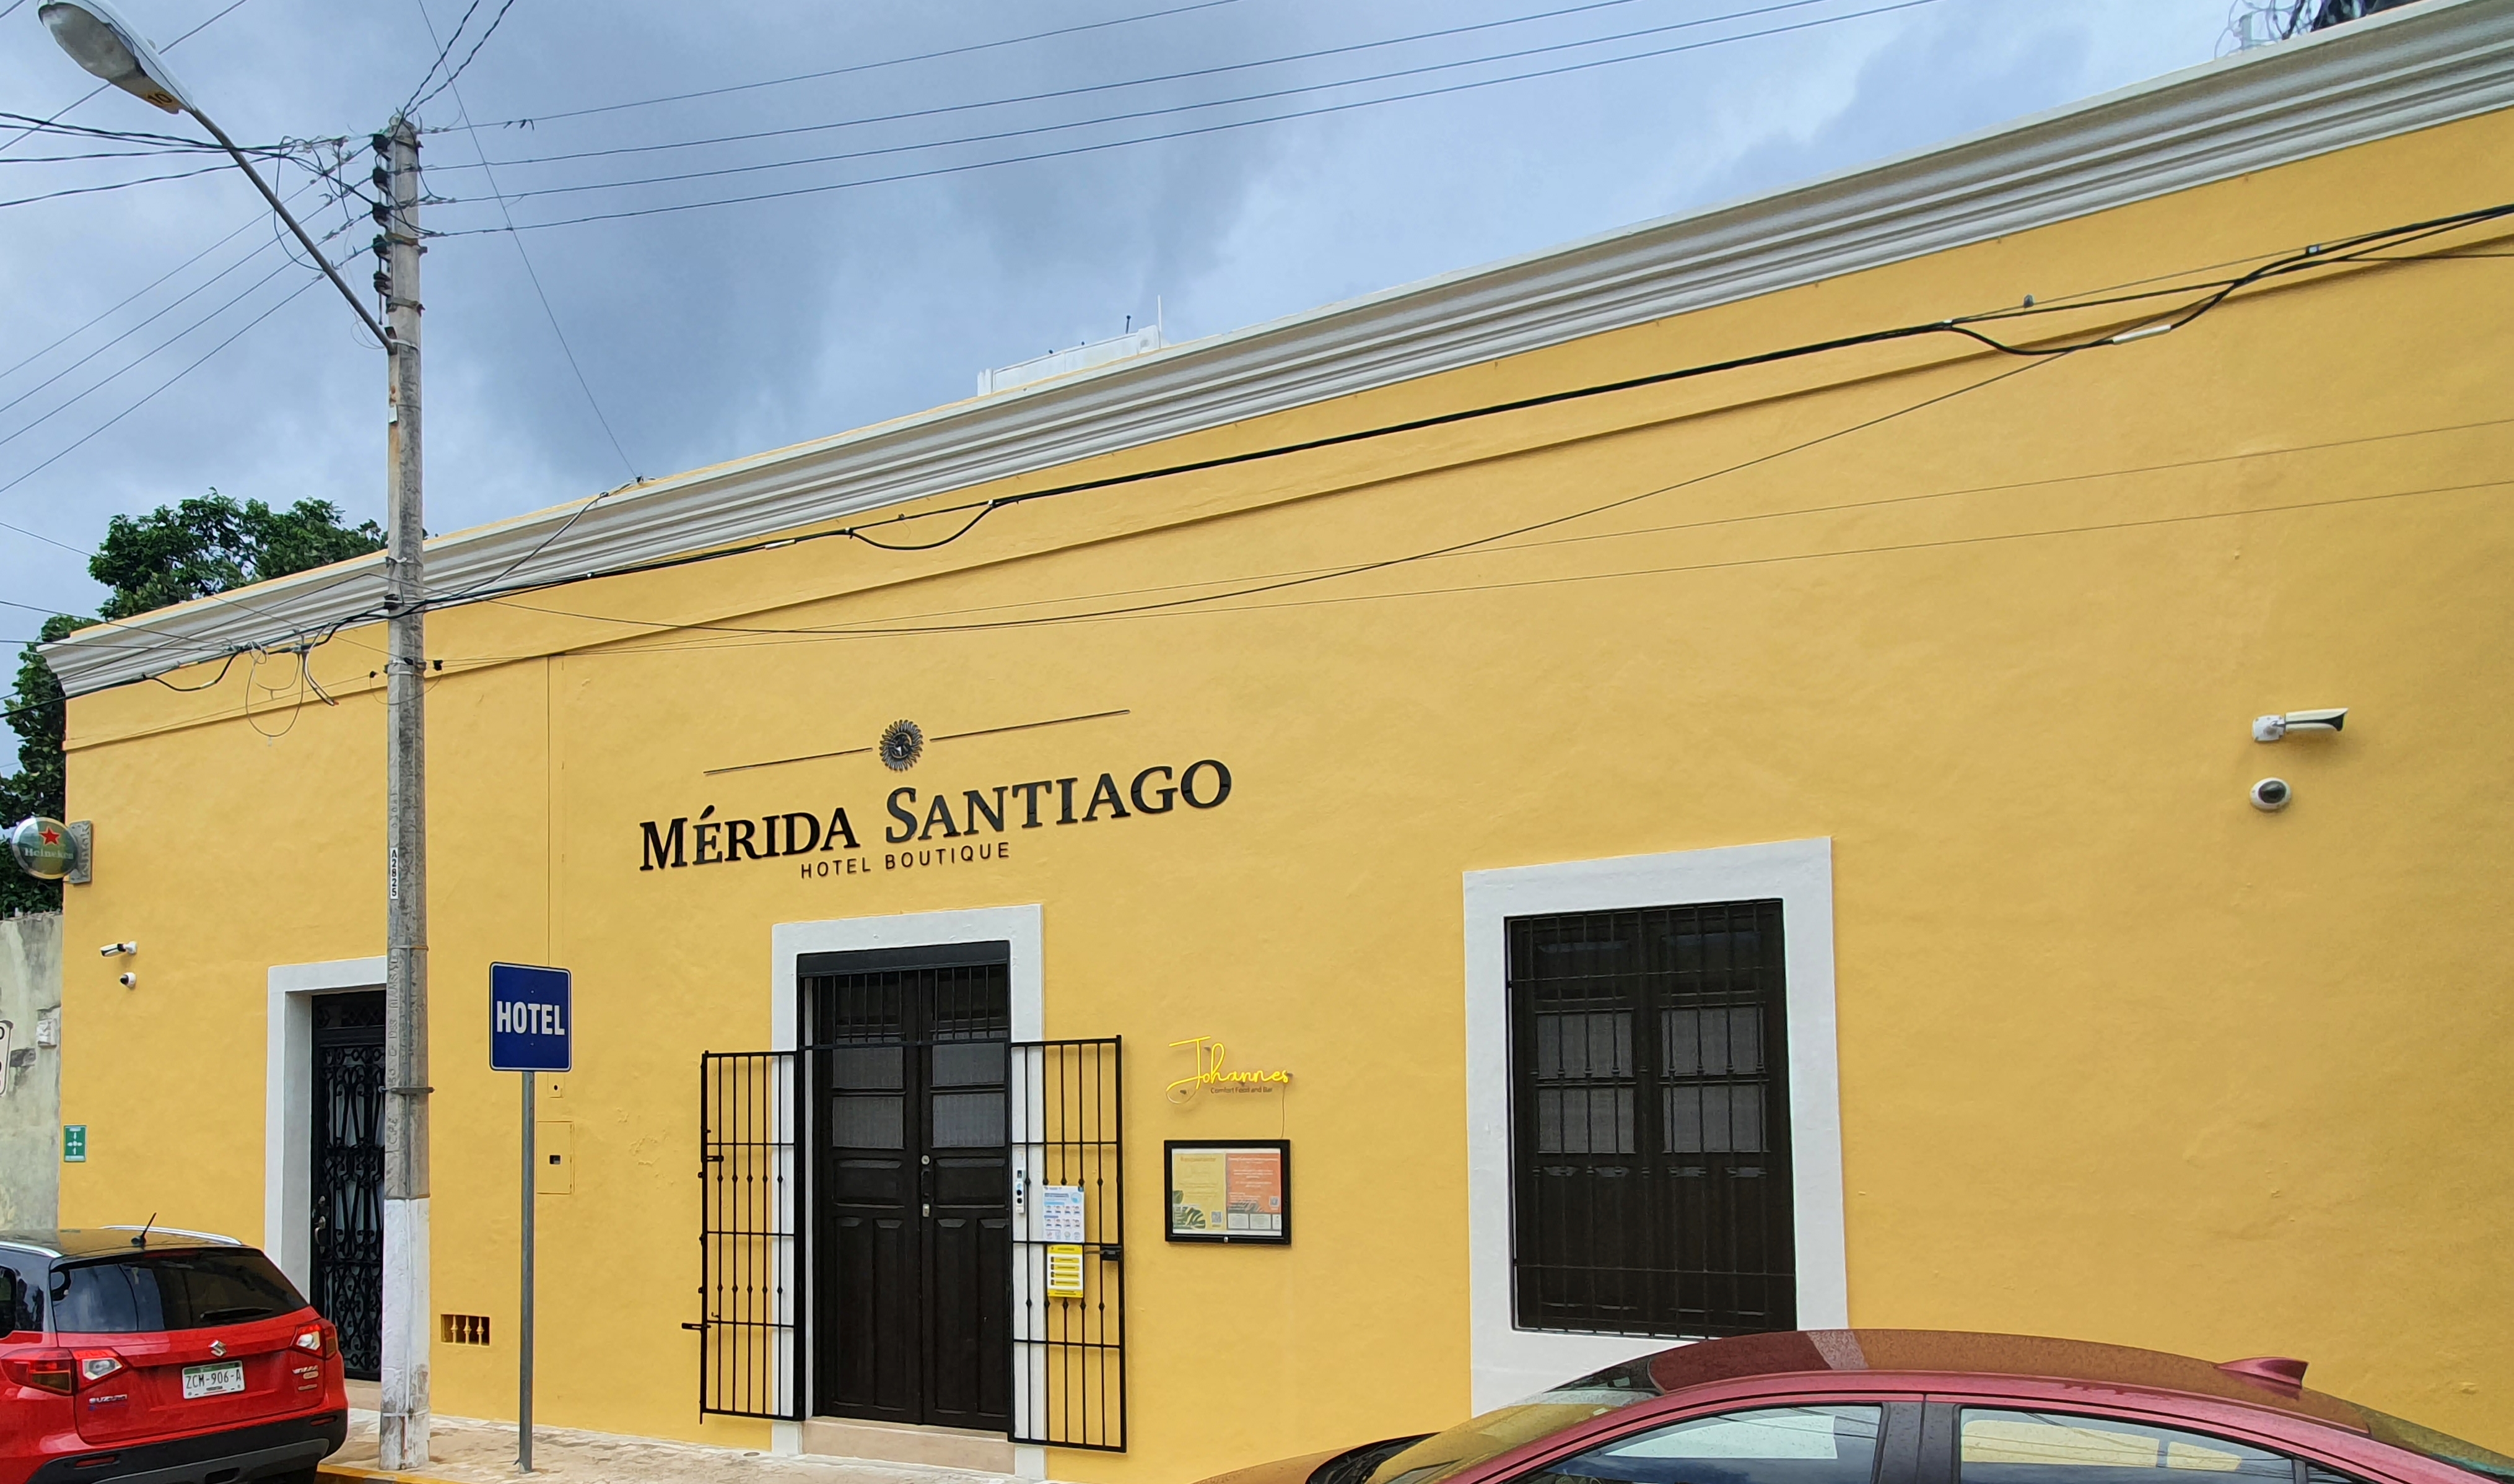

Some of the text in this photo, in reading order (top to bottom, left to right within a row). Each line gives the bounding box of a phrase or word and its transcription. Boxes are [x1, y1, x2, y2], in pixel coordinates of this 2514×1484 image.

[639, 759, 1233, 871] MÉRIDA SANTIAGO
[801, 841, 1010, 879] HOTEL BOUTIQUE
[496, 1000, 565, 1036] HOTEL
[1166, 1035, 1290, 1104] Johannes
